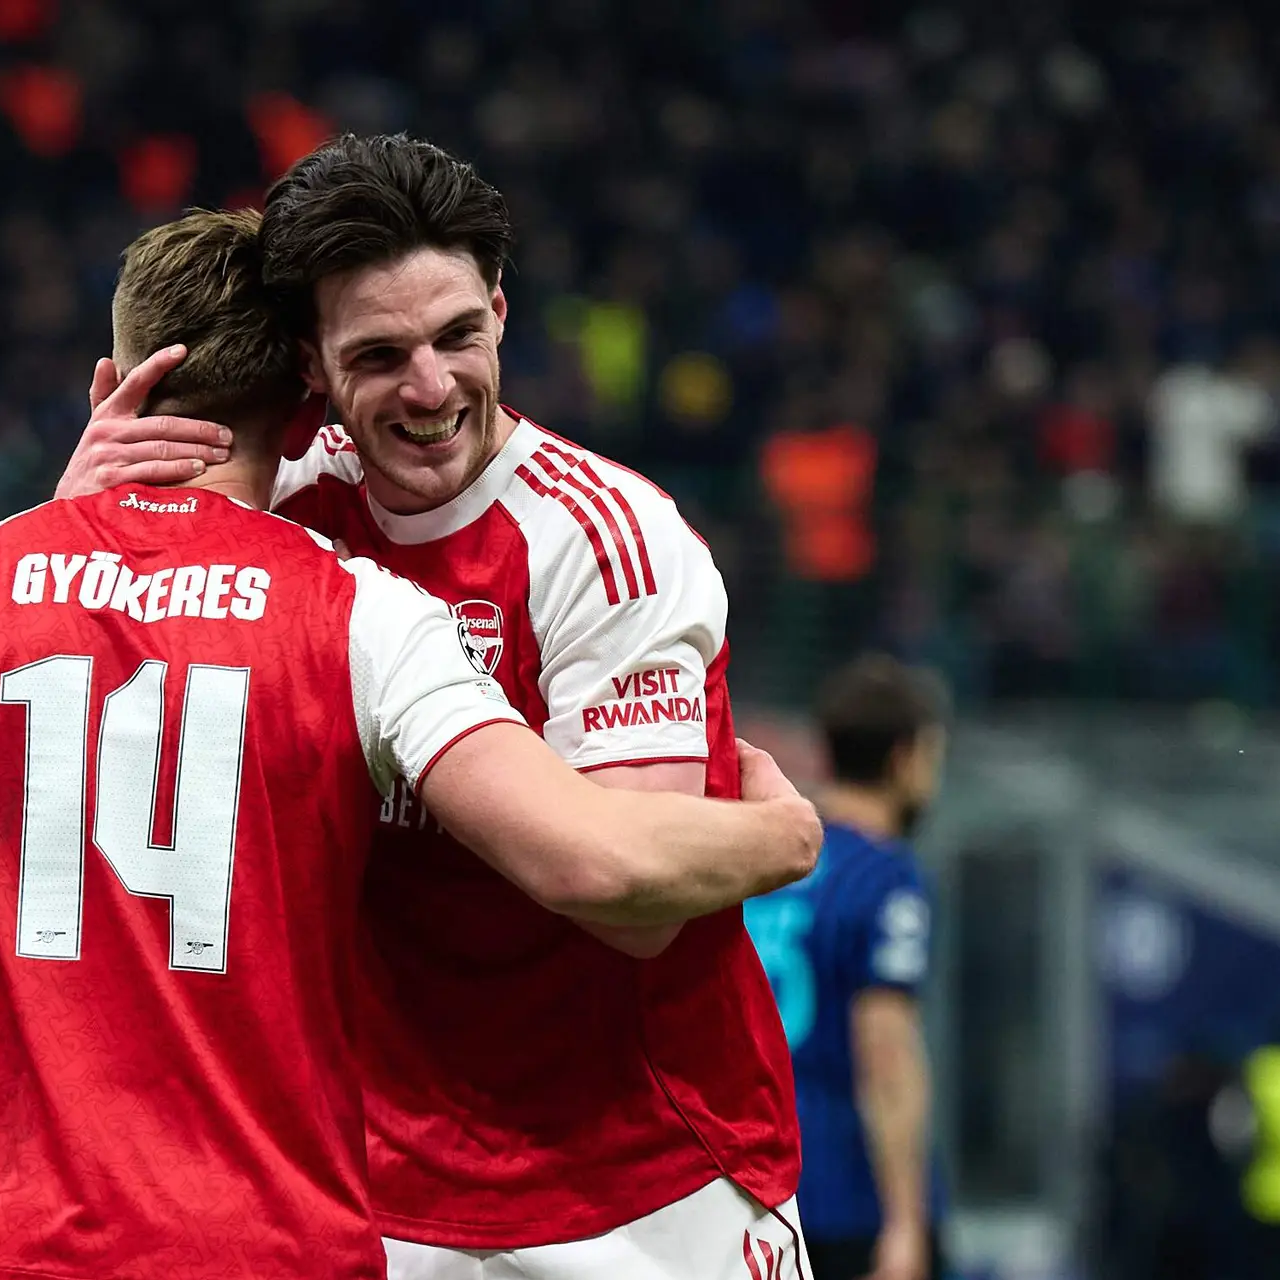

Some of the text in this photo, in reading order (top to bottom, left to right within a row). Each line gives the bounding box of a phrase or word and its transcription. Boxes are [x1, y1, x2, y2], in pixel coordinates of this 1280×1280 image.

[119, 493, 199, 513] Arsenal
[11, 550, 270, 623] GYÖKERES
[611, 668, 680, 699] VISIT
[582, 697, 703, 733] RWANDA
